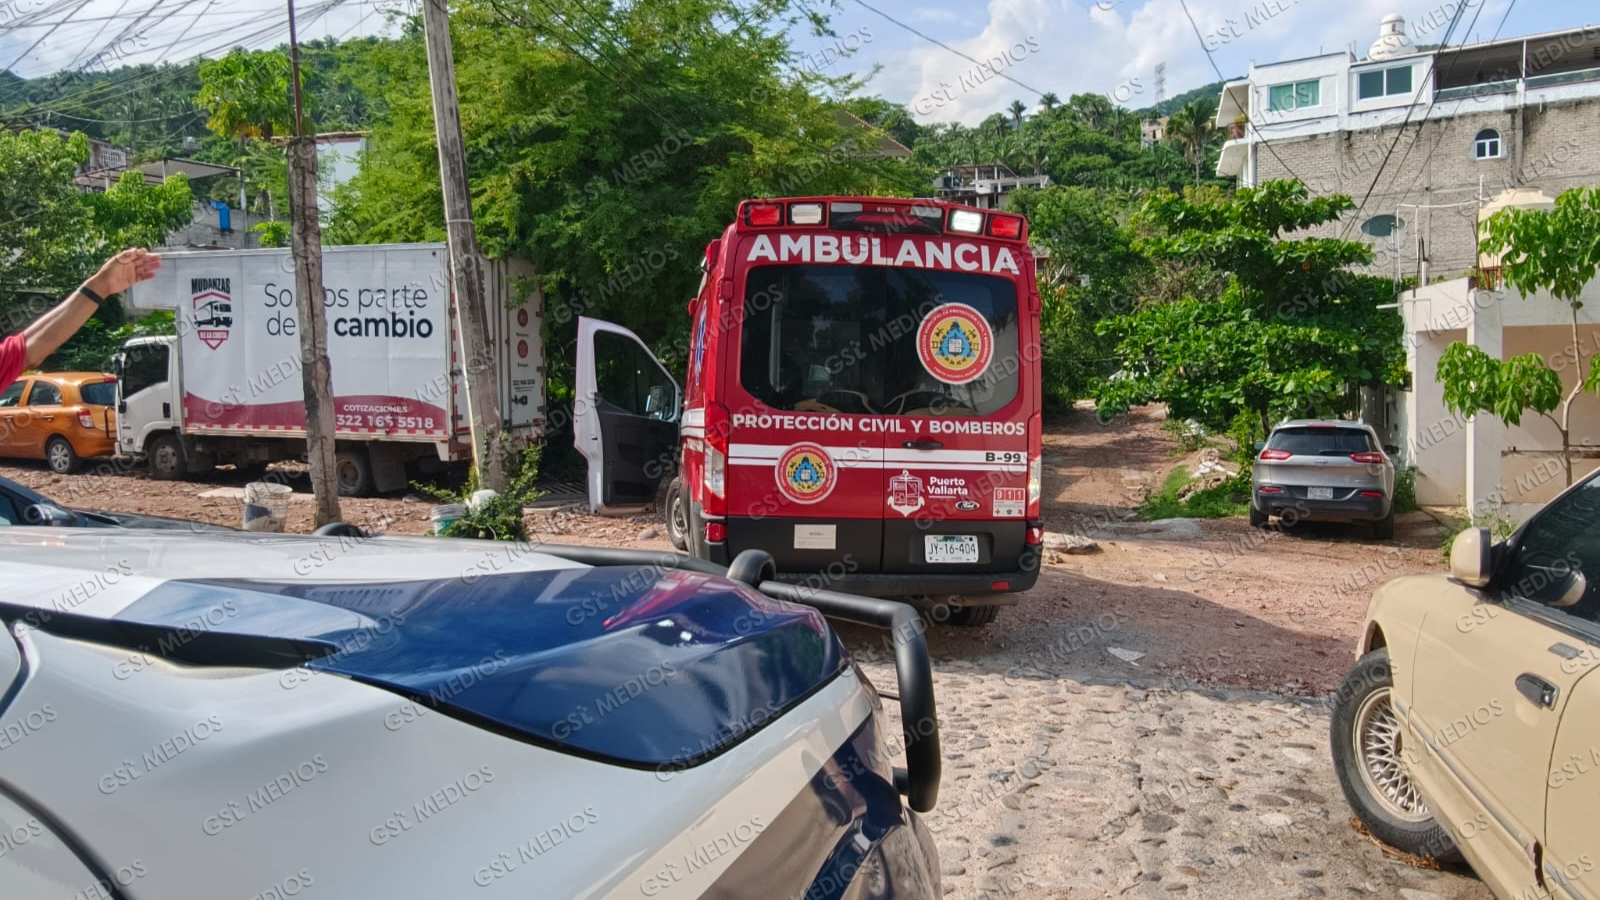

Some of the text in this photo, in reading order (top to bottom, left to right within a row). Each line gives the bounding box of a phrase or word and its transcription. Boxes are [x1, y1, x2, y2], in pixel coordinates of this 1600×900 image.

[746, 234, 1020, 275] AMBULANCIA
[192, 278, 231, 295] MUDANZAS
[264, 283, 428, 314] Soos parte
[267, 310, 433, 338] de cambio
[343, 404, 408, 413] COTIZACIONES
[336, 415, 362, 426] 322
[398, 416, 434, 428] 5518
[732, 414, 1025, 436] PROTECCIÓN CIVIL Y BOMBEROS
[985, 452, 1021, 463] B-99
[930, 476, 965, 485] Puerto
[927, 486, 968, 495] Vallarta
[996, 490, 1022, 499] 911
[929, 542, 976, 554] JY-16-404
